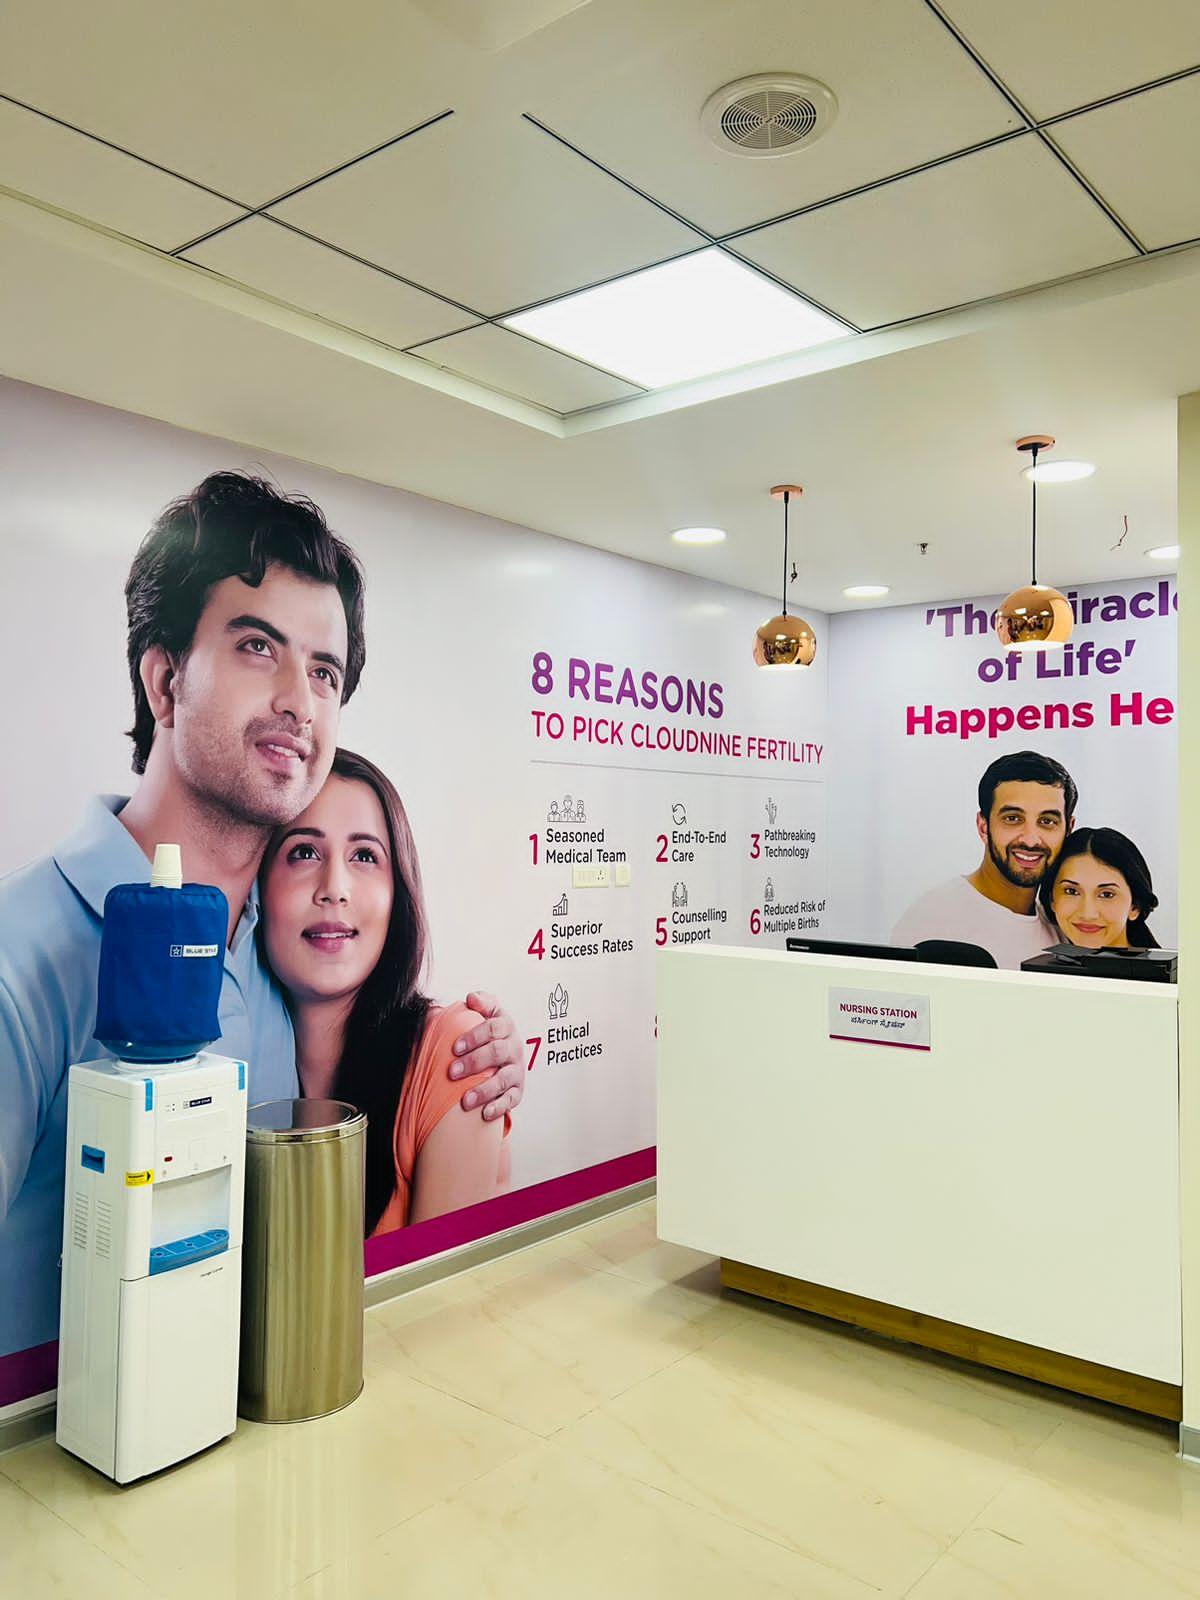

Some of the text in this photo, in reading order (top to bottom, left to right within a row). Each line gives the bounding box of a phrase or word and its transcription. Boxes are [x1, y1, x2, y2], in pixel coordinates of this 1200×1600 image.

[926, 581, 1178, 637] 'Th iracl
[978, 640, 1136, 683] of Life'
[531, 651, 724, 719] 8 REASONS
[906, 692, 1174, 740] Happens He
[531, 710, 823, 764] TO PICK CLOUDNINE FERTILITY
[546, 828, 605, 843] Seasoned
[672, 830, 727, 844] End-To-End
[750, 833, 761, 859] 3
[764, 829, 816, 843] Pathbreaking
[529, 833, 538, 866] 1
[546, 848, 627, 864] Medical Team
[655, 834, 669, 863] 2
[672, 849, 695, 862] Care
[764, 845, 810, 859] Technology
[672, 908, 728, 925] Counselling
[763, 899, 826, 916] Reduced Risk of
[551, 919, 603, 939] Superior
[655, 917, 668, 946] 5
[750, 908, 761, 935] 6
[763, 916, 820, 933] Multiple Births
[527, 928, 546, 961] 4
[672, 927, 711, 945] Support
[550, 938, 634, 960] Success Rates
[839, 1003, 918, 1019] NURSING STATION
[547, 1021, 590, 1044] Ethical
[526, 1037, 542, 1071] 7
[547, 1043, 603, 1066] Practices
